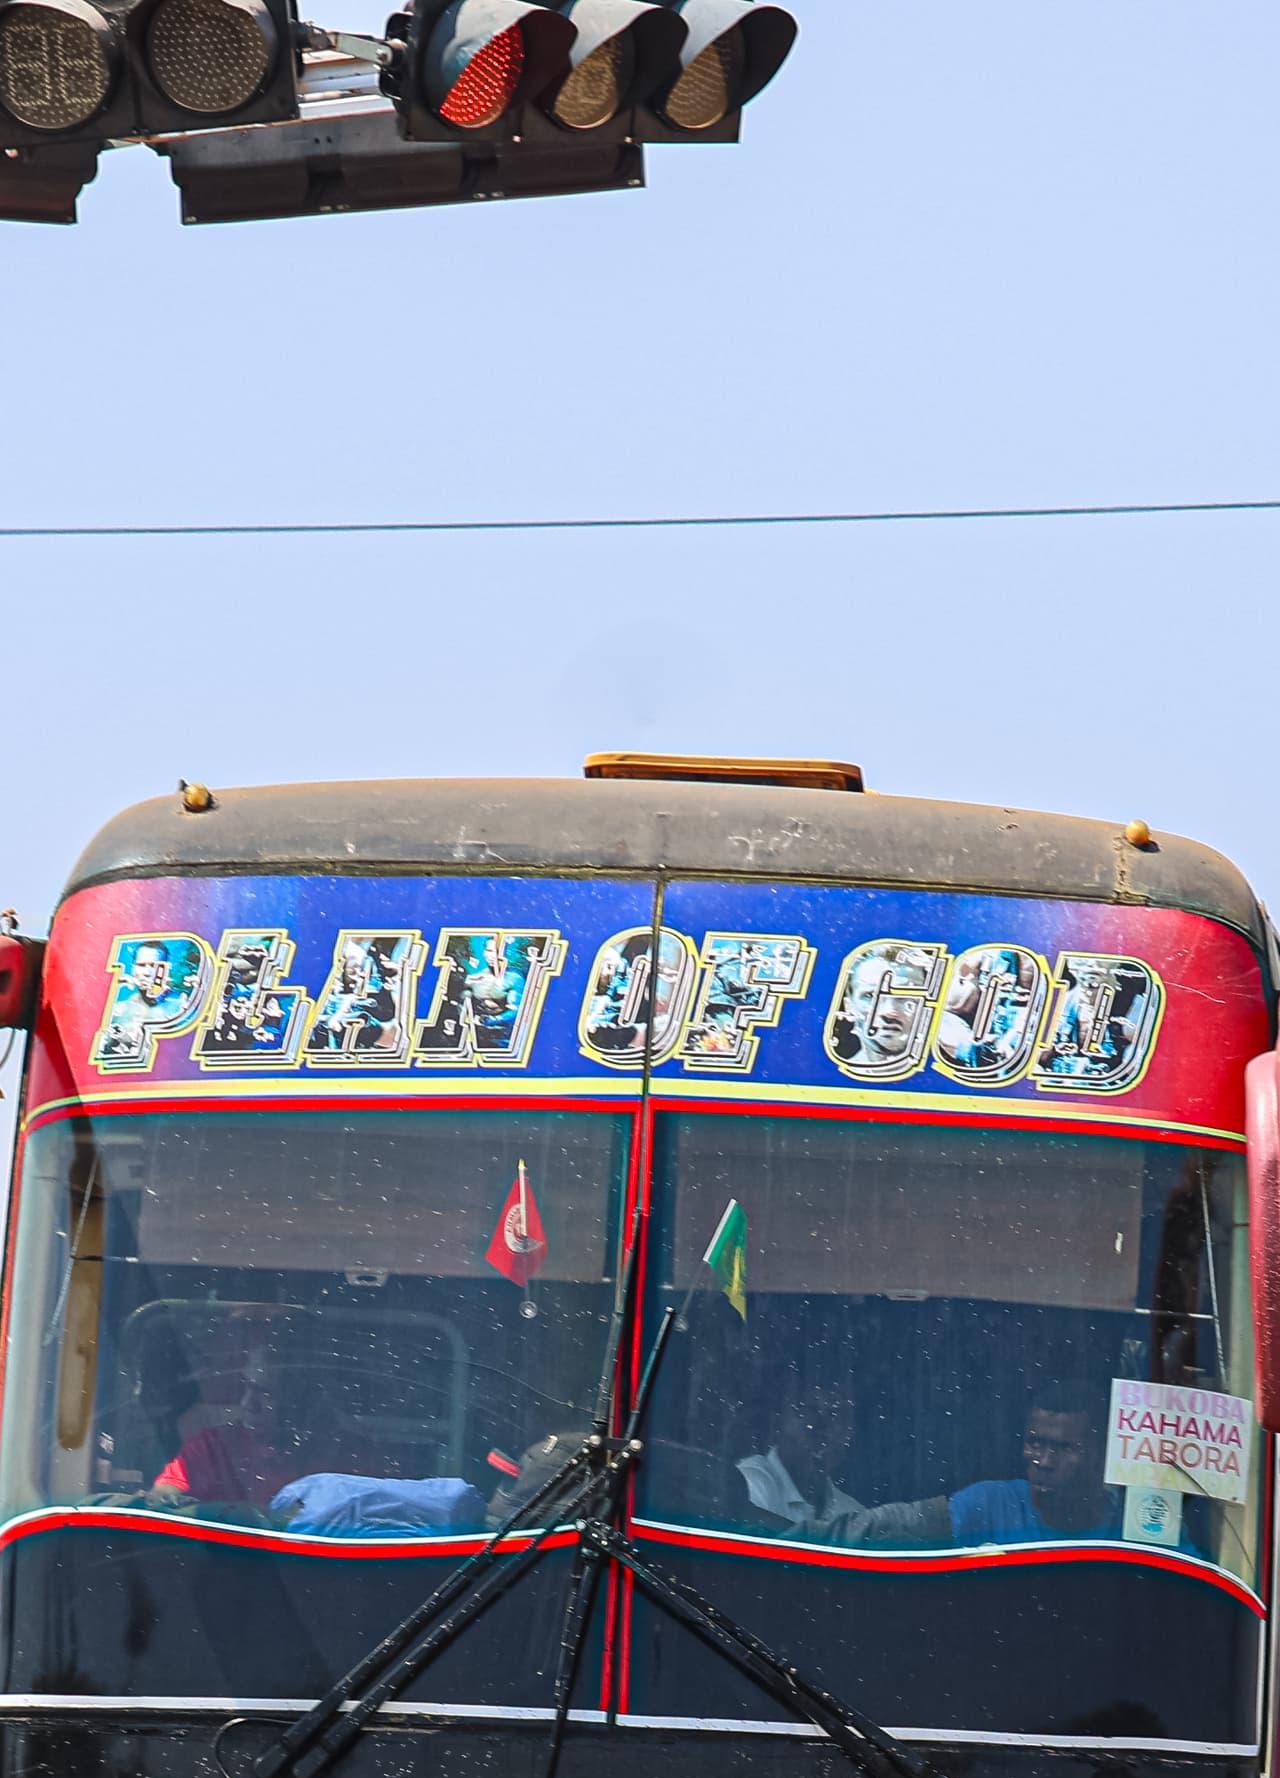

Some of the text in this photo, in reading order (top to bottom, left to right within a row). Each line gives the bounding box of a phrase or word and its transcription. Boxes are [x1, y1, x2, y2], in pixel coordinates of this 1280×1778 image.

[88, 926, 1167, 1093] PLAN OF GOD
[1120, 1382, 1245, 1425] BUKOBA
[1117, 1408, 1242, 1449] KAHAMA
[1117, 1434, 1241, 1477] TABORA
